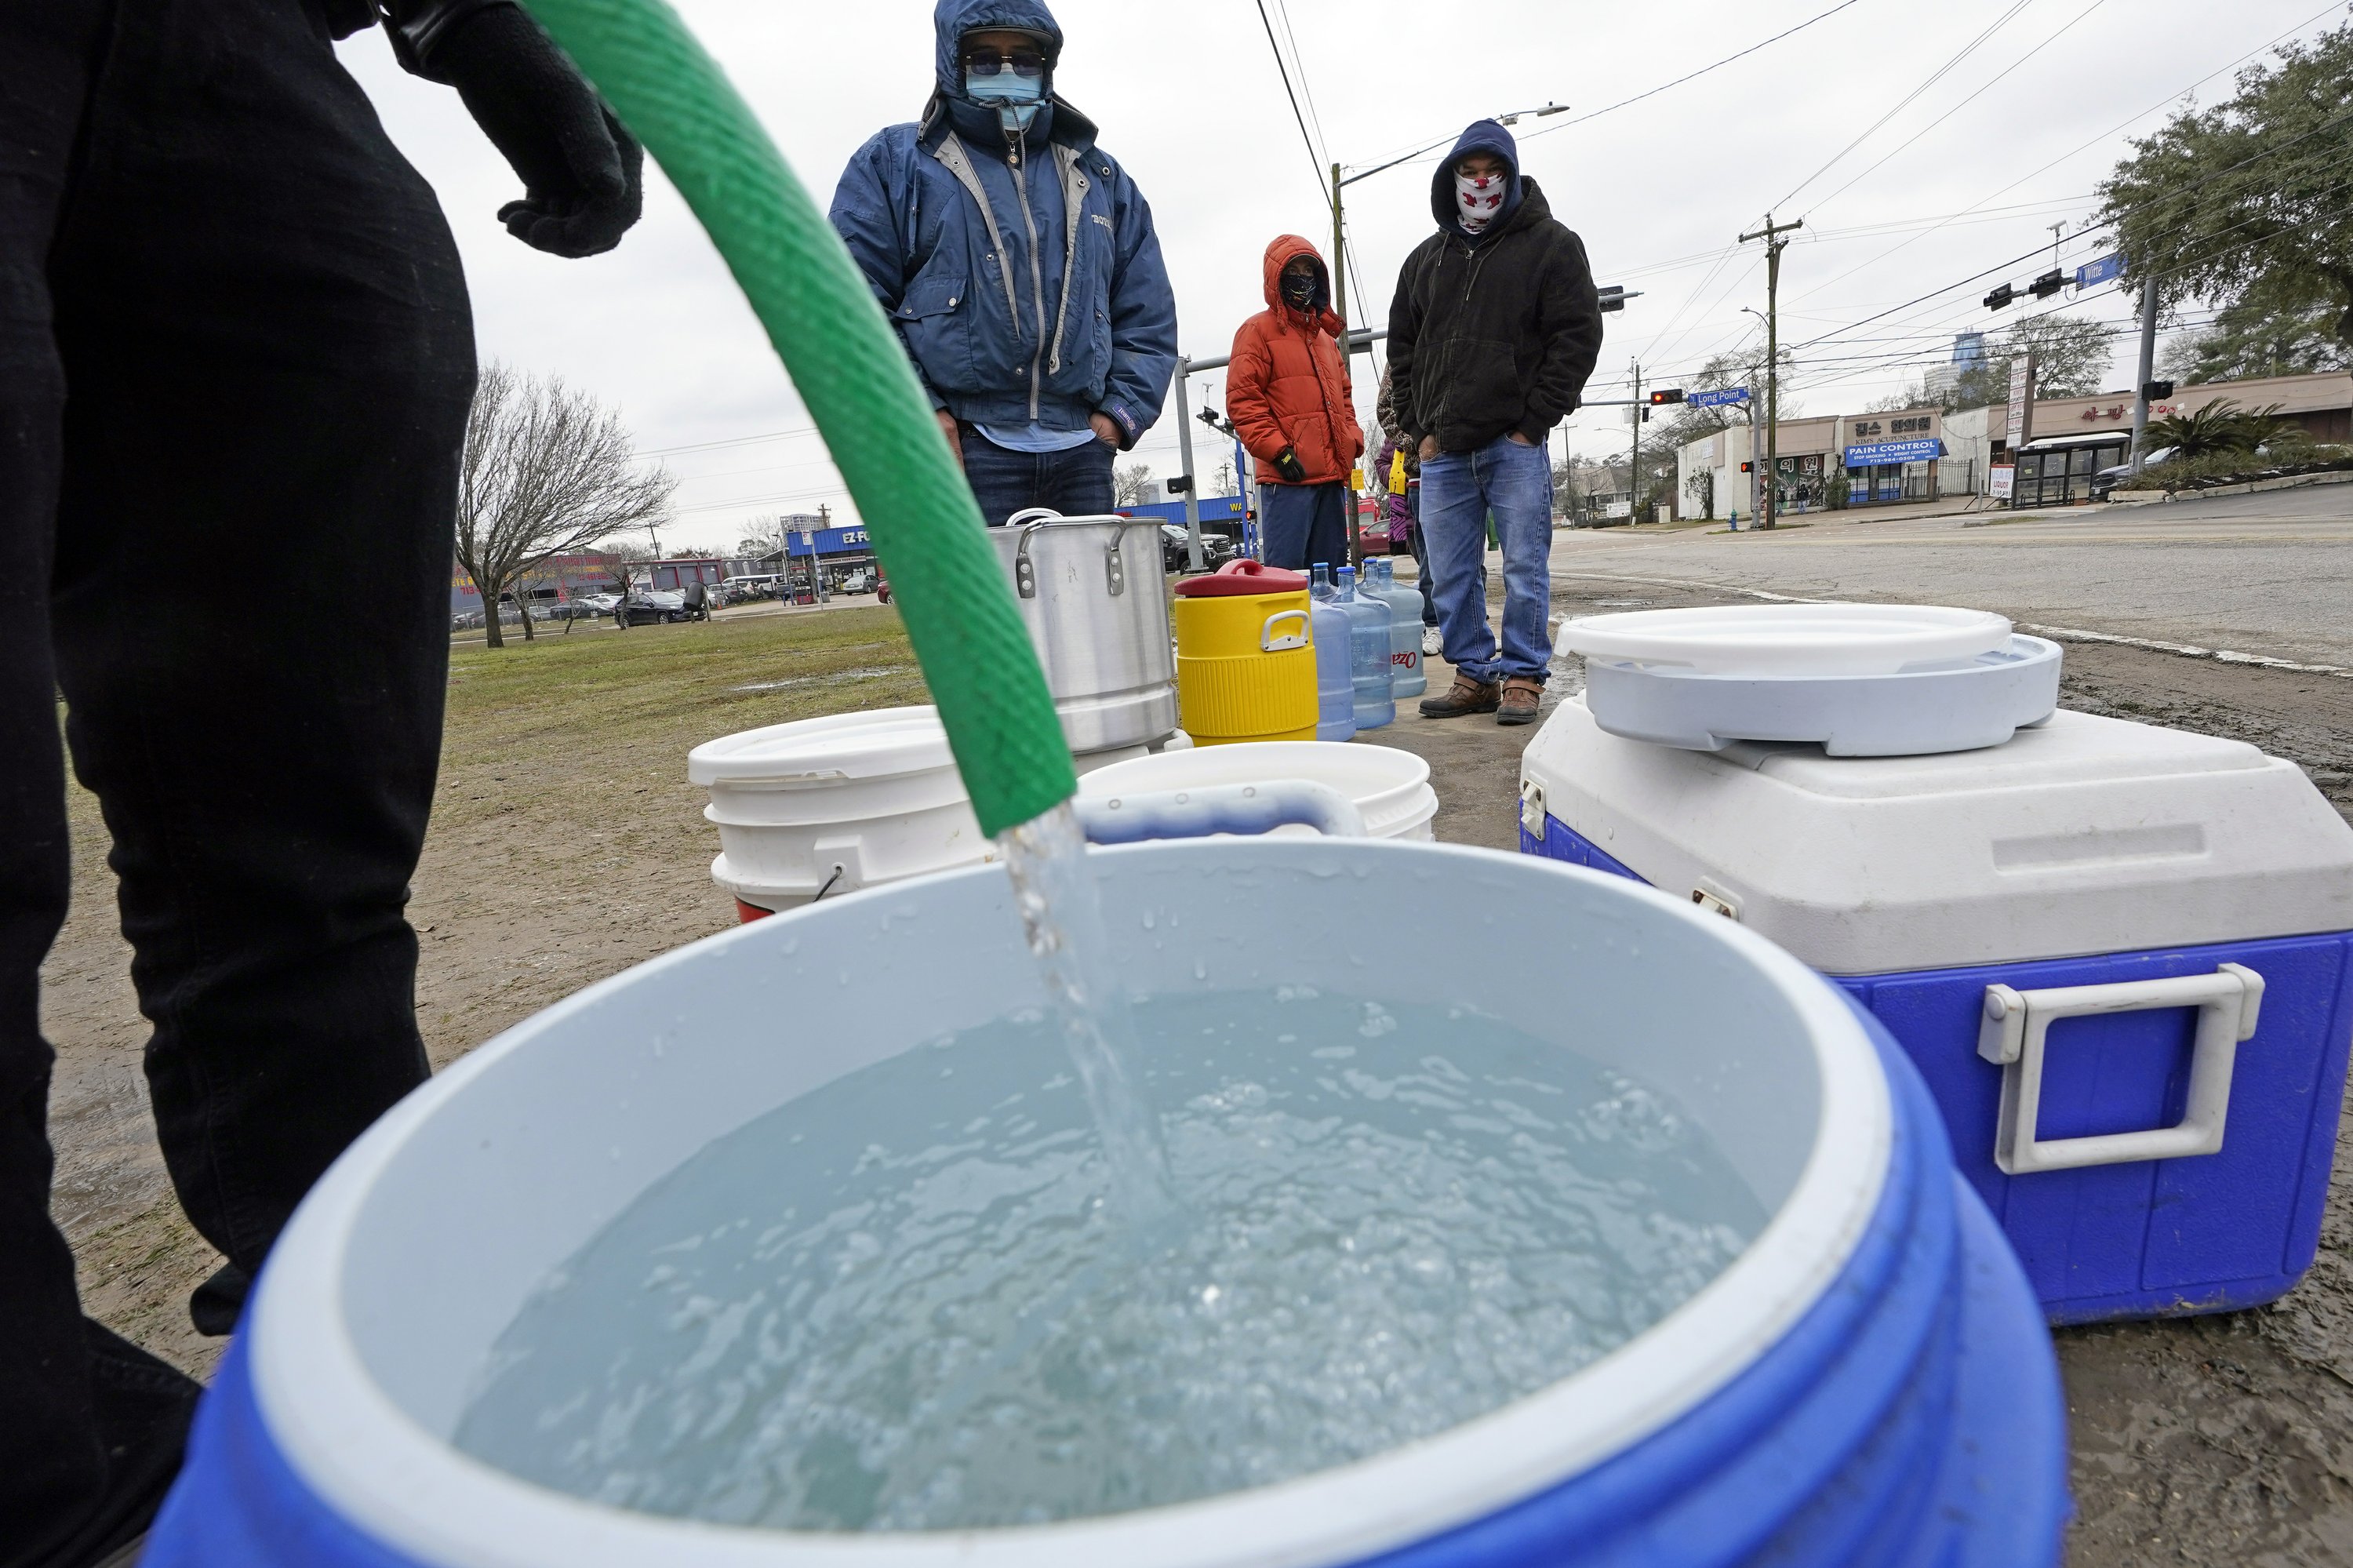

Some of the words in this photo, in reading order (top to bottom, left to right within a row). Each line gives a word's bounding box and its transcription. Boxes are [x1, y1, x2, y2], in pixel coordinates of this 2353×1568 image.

[2085, 265, 2103, 280] Witte
[1698, 394, 1718, 403] Long
[1719, 390, 1740, 400] Point
[1855, 421, 1882, 436] 김스
[1890, 416, 1931, 433] 한의원
[1877, 433, 1929, 444] ACUPUNCTURE
[1849, 446, 1876, 455] PAIN
[1880, 441, 1935, 452] CONTROL
[1992, 470, 2003, 479] USA
